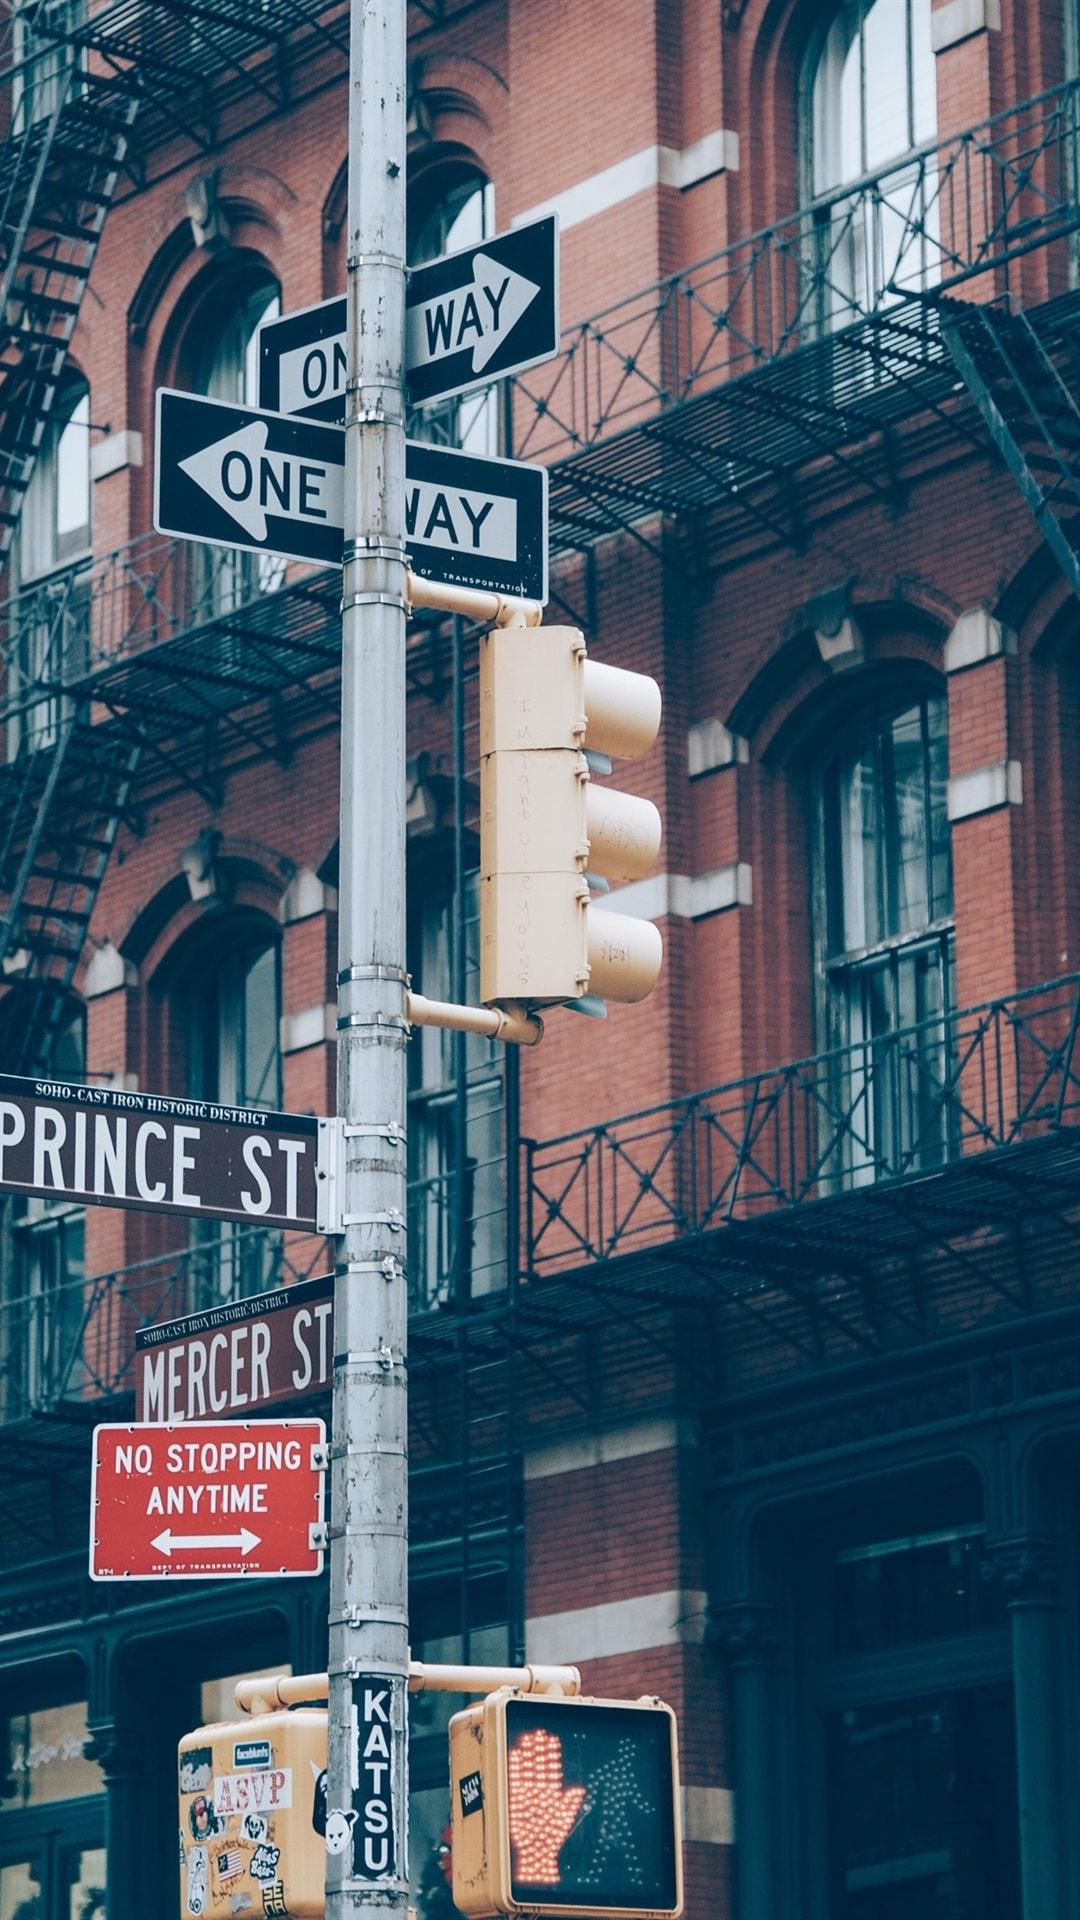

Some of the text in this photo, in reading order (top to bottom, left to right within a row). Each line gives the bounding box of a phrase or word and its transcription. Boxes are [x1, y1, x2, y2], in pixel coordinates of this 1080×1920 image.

[303, 277, 510, 399] ON WAY
[220, 450, 327, 519] ONE
[443, 572, 528, 593] TRANSPORTATION
[112, 1093, 144, 1110] IRON
[147, 1098, 207, 1117] HISTORIC
[209, 1107, 268, 1126] DISTRICT
[0, 1101, 306, 1220] PRINCE ST
[188, 1315, 209, 1332] IRON
[142, 1303, 332, 1420] MERCER ST
[115, 1441, 301, 1474] NO STOPPING
[146, 1484, 268, 1515] ANYTIME
[190, 1562, 260, 1570] TRANSPORTATION
[217, 1772, 286, 1813] ASVP
[363, 1689, 390, 1871] KATSU
